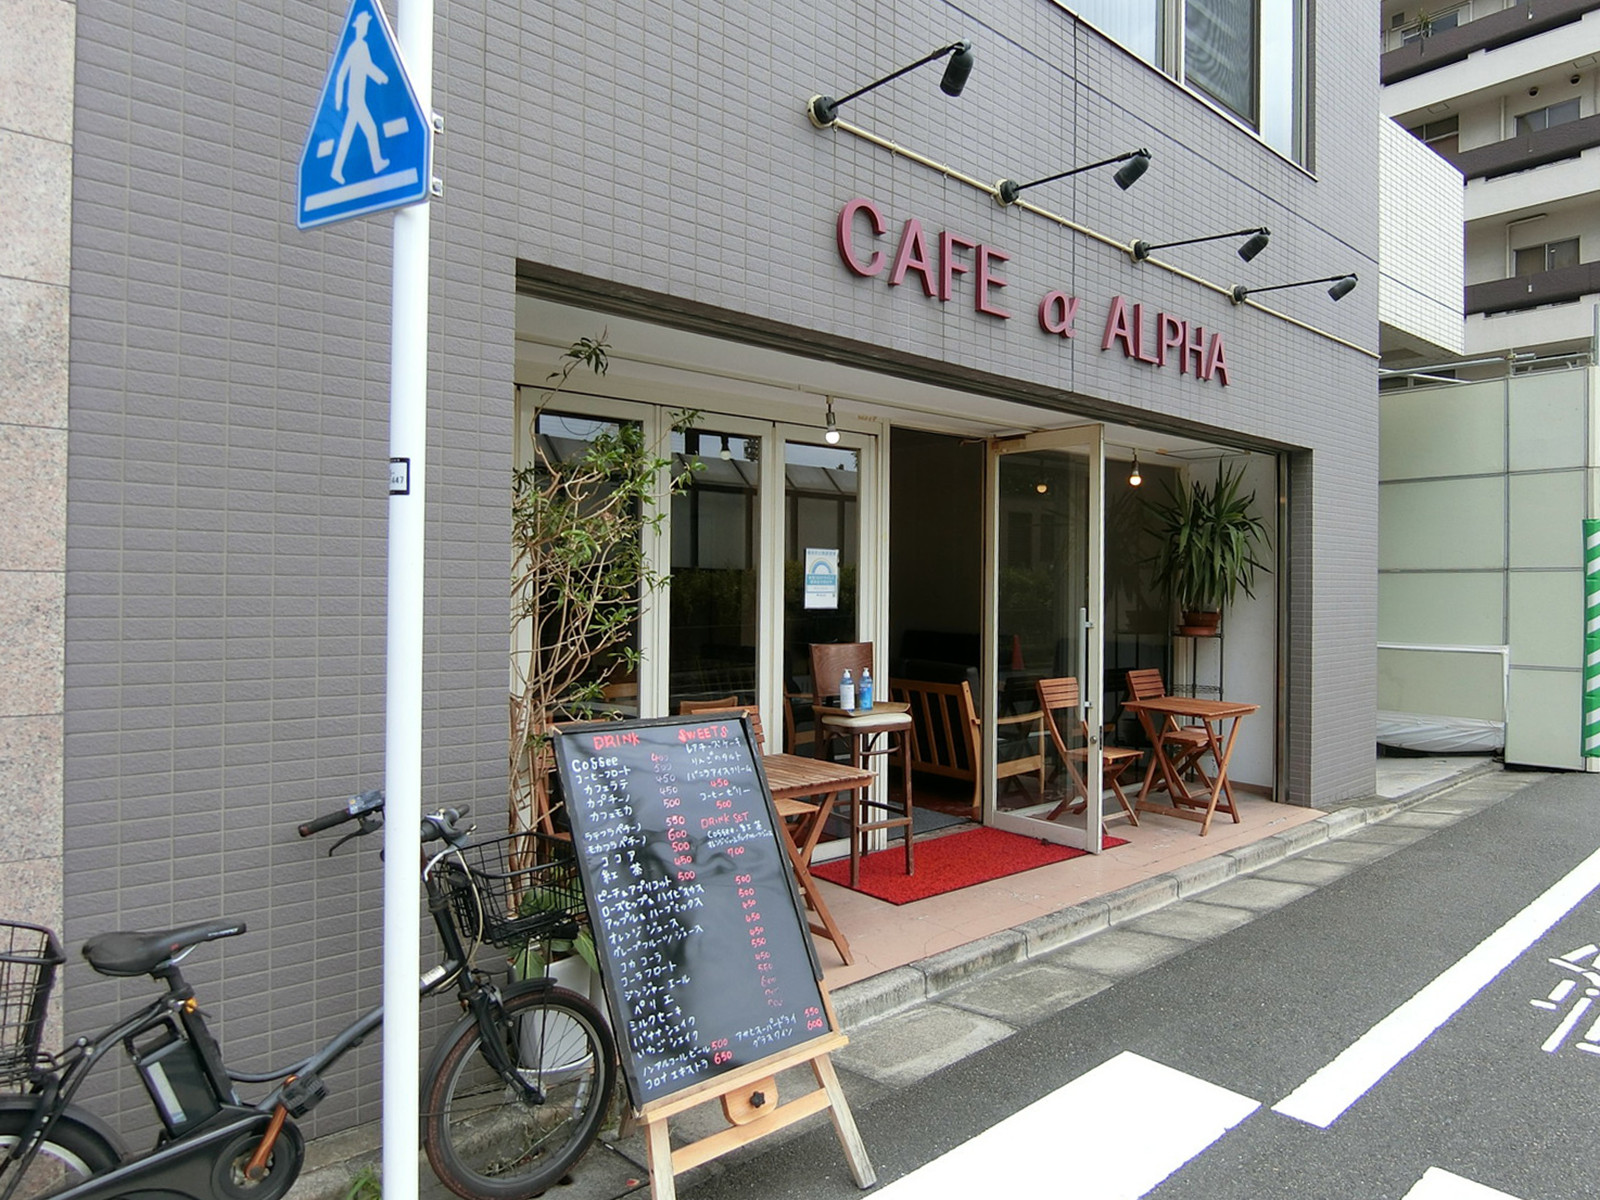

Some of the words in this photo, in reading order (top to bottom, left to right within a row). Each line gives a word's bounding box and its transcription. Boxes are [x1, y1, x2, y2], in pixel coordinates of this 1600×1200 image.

[836, 198, 1011, 319] CAFE
[1101, 295, 1231, 387] ALPHA
[678, 725, 728, 743] SWEETS
[593, 731, 640, 750] DRINK
[686, 737, 741, 754] レアチーズケーキ
[571, 756, 618, 772] Coffee
[576, 765, 631, 784] コーヒーフロート
[656, 774, 676, 783] 450
[687, 764, 753, 781] バニラアイスクリーム
[584, 779, 629, 795] カフェラテ
[710, 778, 729, 788] 450
[659, 786, 678, 795] 450
[586, 794, 630, 808] カプチーノ
[663, 798, 681, 808] 500
[715, 799, 732, 809] 500
[590, 805, 632, 822] カフェモカ
[665, 816, 685, 826] 550
[700, 813, 730, 829] DRINK
[732, 811, 749, 823] SET
[585, 822, 642, 841] ラテフラペチーノ
[667, 828, 687, 841] 600
[587, 835, 647, 854] モカフラペチーノ
[671, 841, 690, 852] 500
[727, 846, 745, 857] 700
[674, 855, 692, 866] 450
[677, 870, 696, 881] 500
[735, 874, 751, 884] 500
[738, 887, 754, 898] 500
[742, 899, 756, 909] 450
[745, 912, 761, 922] 450
[749, 926, 764, 936] 450
[751, 937, 766, 948] 550
[804, 1006, 819, 1018] 550
[629, 1006, 681, 1032] ミルクセーキ
[807, 1018, 823, 1030] 600
[711, 1038, 728, 1051] 500
[643, 1045, 711, 1077] ノンアルコールビール
[714, 1050, 733, 1065] 650
